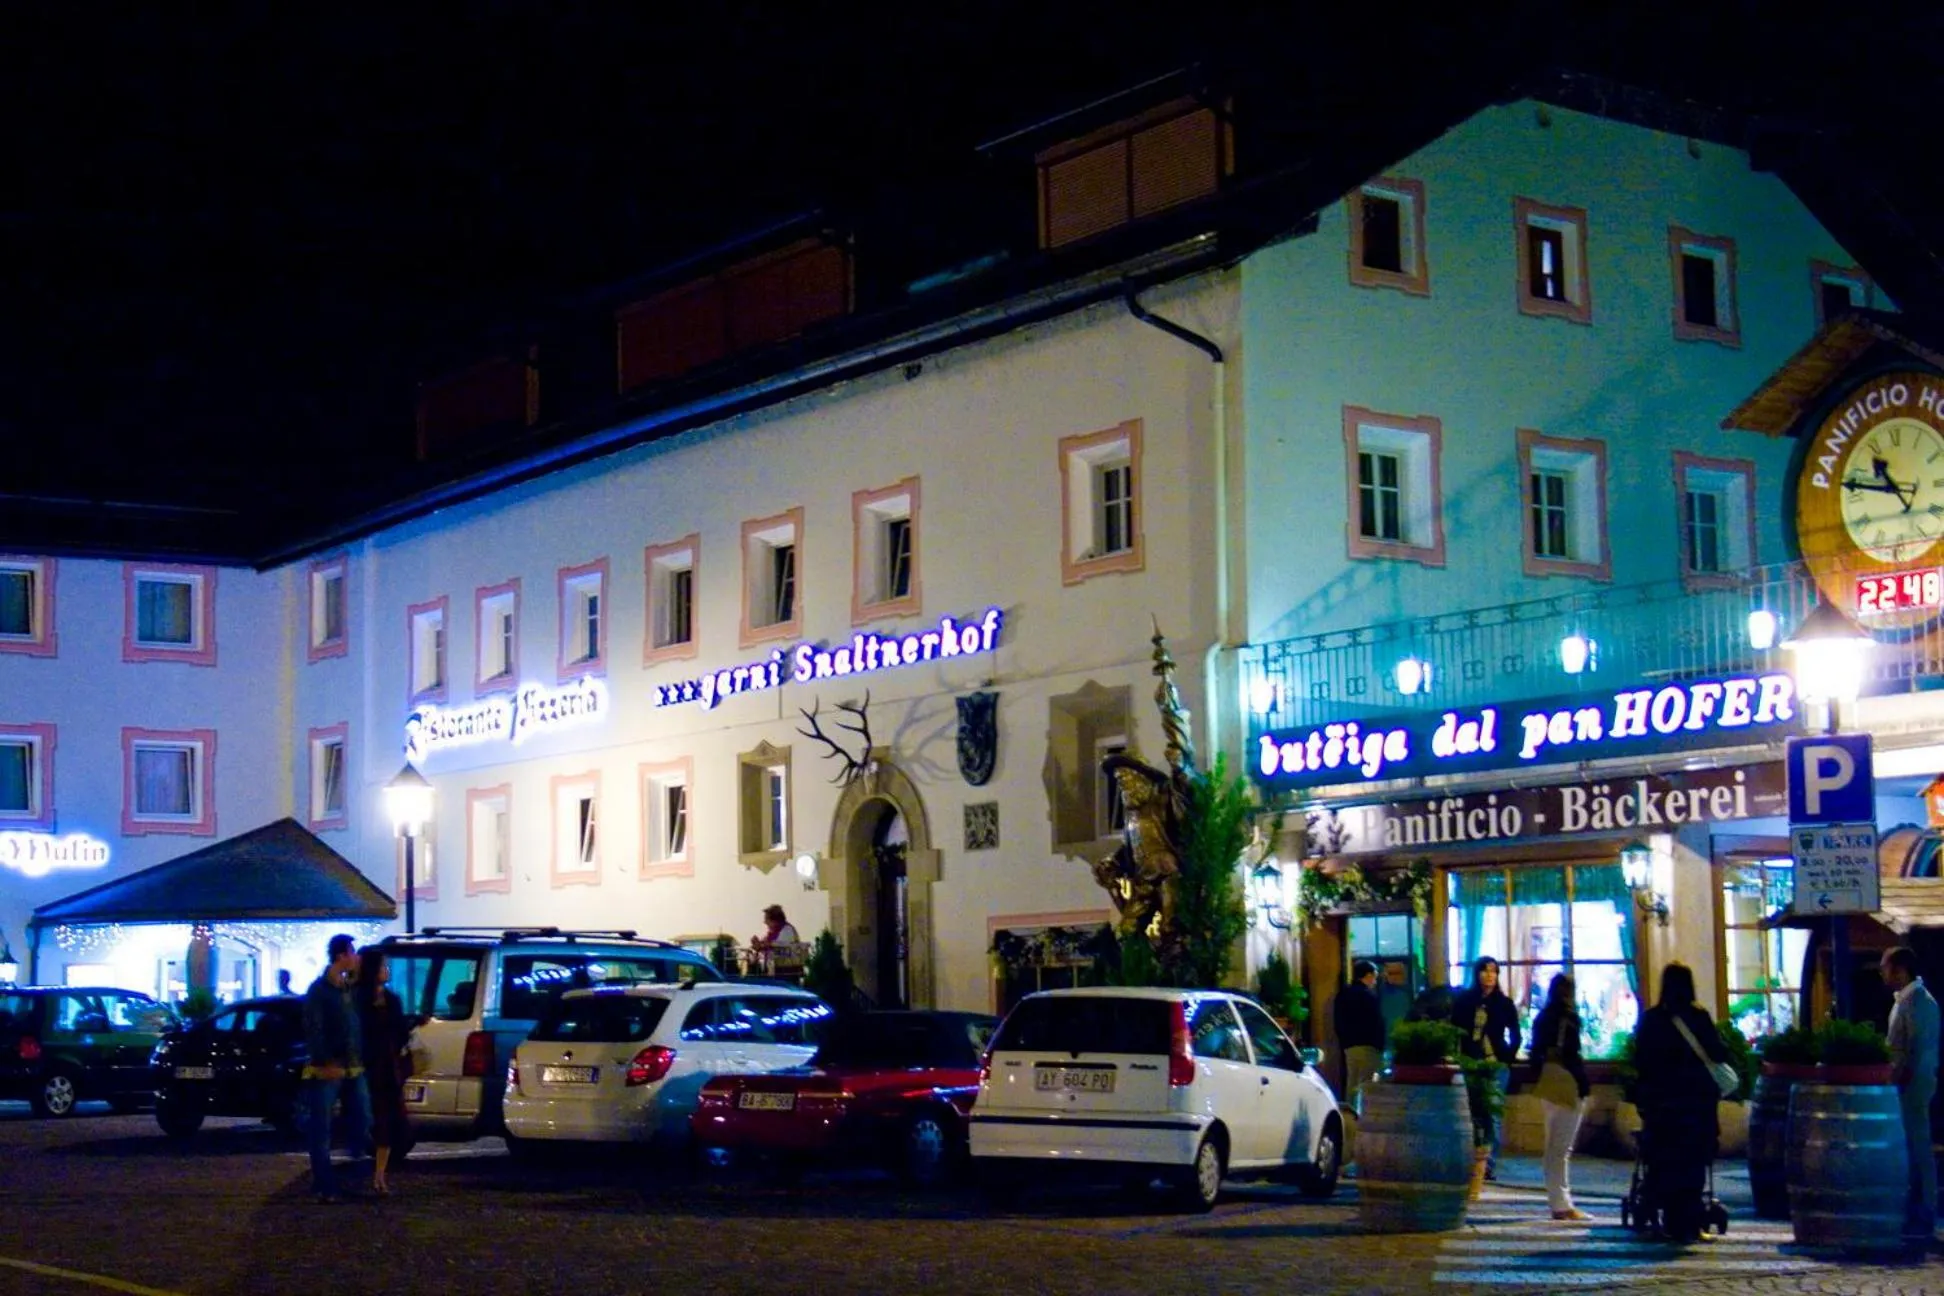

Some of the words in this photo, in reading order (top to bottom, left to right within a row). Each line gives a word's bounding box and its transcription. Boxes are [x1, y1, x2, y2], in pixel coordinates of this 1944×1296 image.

[1812, 383, 1908, 489] PANIFICIO
[700, 650, 786, 710] garni
[1431, 708, 1497, 758] dal
[1518, 706, 1603, 759] pan
[1608, 674, 1794, 738] HOFER
[1361, 794, 1523, 848] Panificio
[1559, 769, 1748, 832] Bäckerei
[1803, 746, 1854, 815] P
